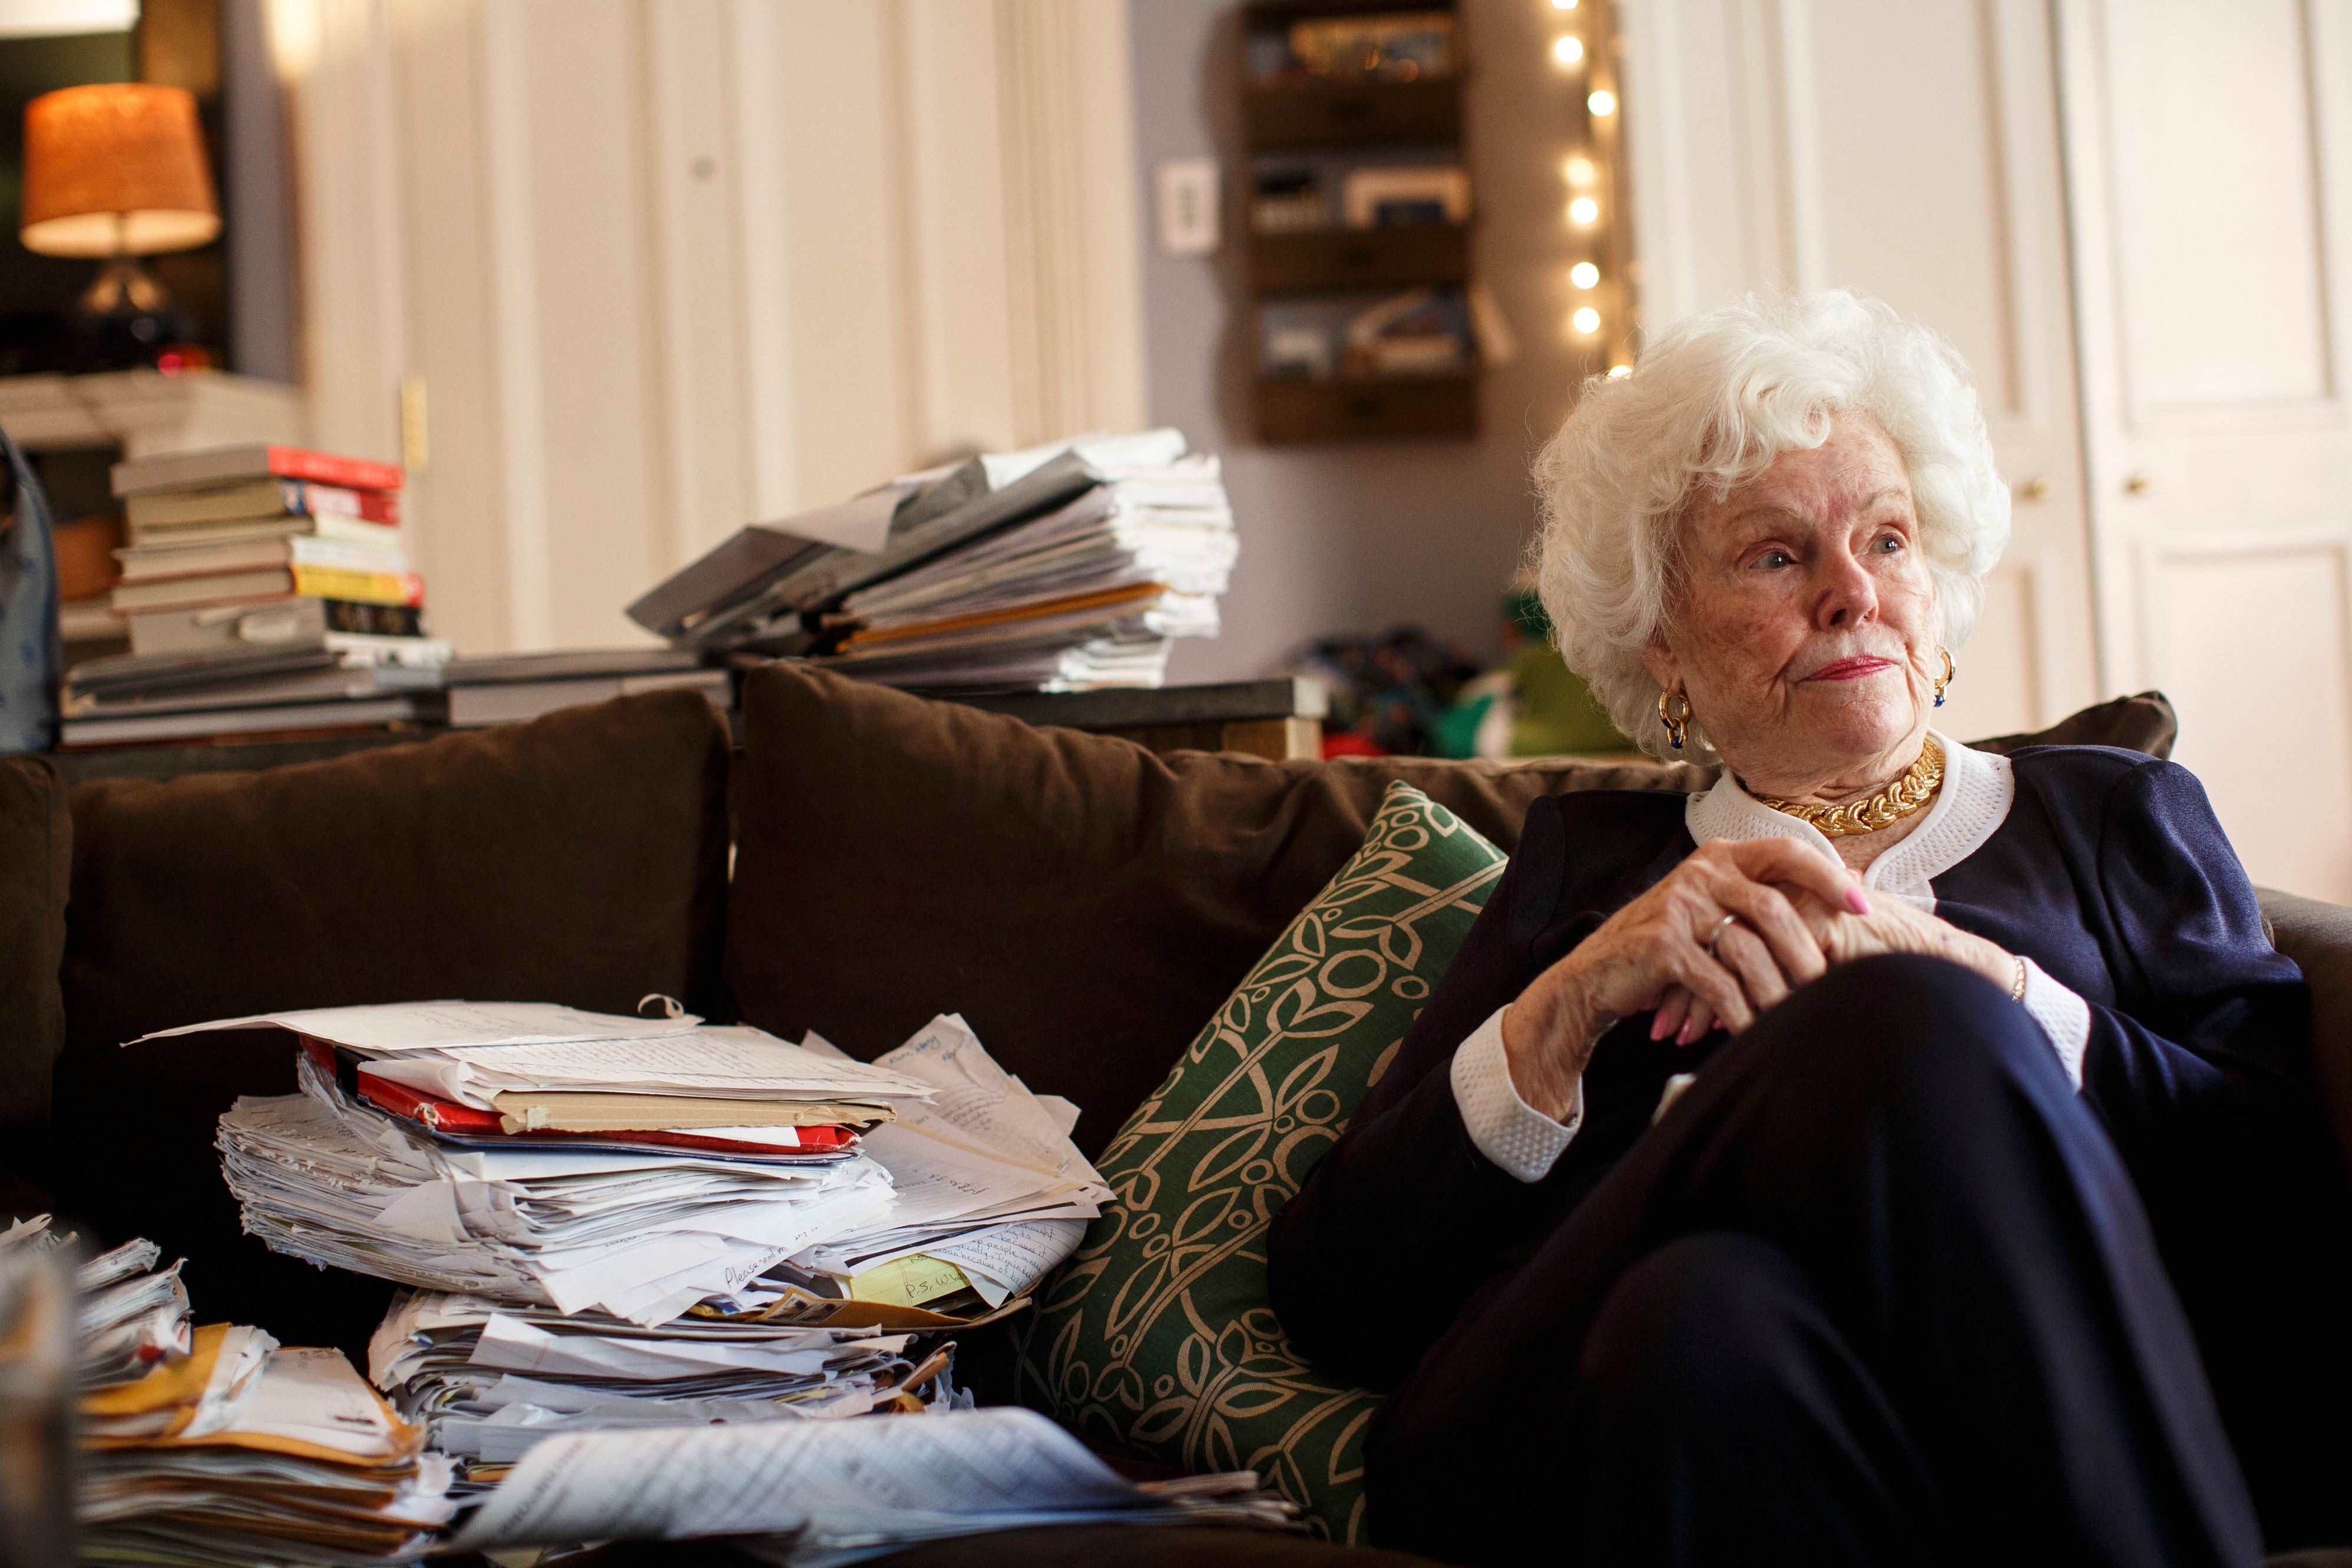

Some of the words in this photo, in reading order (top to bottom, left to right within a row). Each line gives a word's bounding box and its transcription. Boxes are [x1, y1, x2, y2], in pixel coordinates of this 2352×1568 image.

[1019, 1230, 1031, 1239] to
[1020, 1223, 1055, 1241] thought
[987, 1243, 1017, 1257] people
[1001, 1234, 1036, 1254] because
[1038, 1245, 1046, 1256] it
[725, 1262, 759, 1288] Please
[759, 1247, 776, 1263] send
[961, 1251, 995, 1269] because
[998, 1264, 1008, 1273] of
